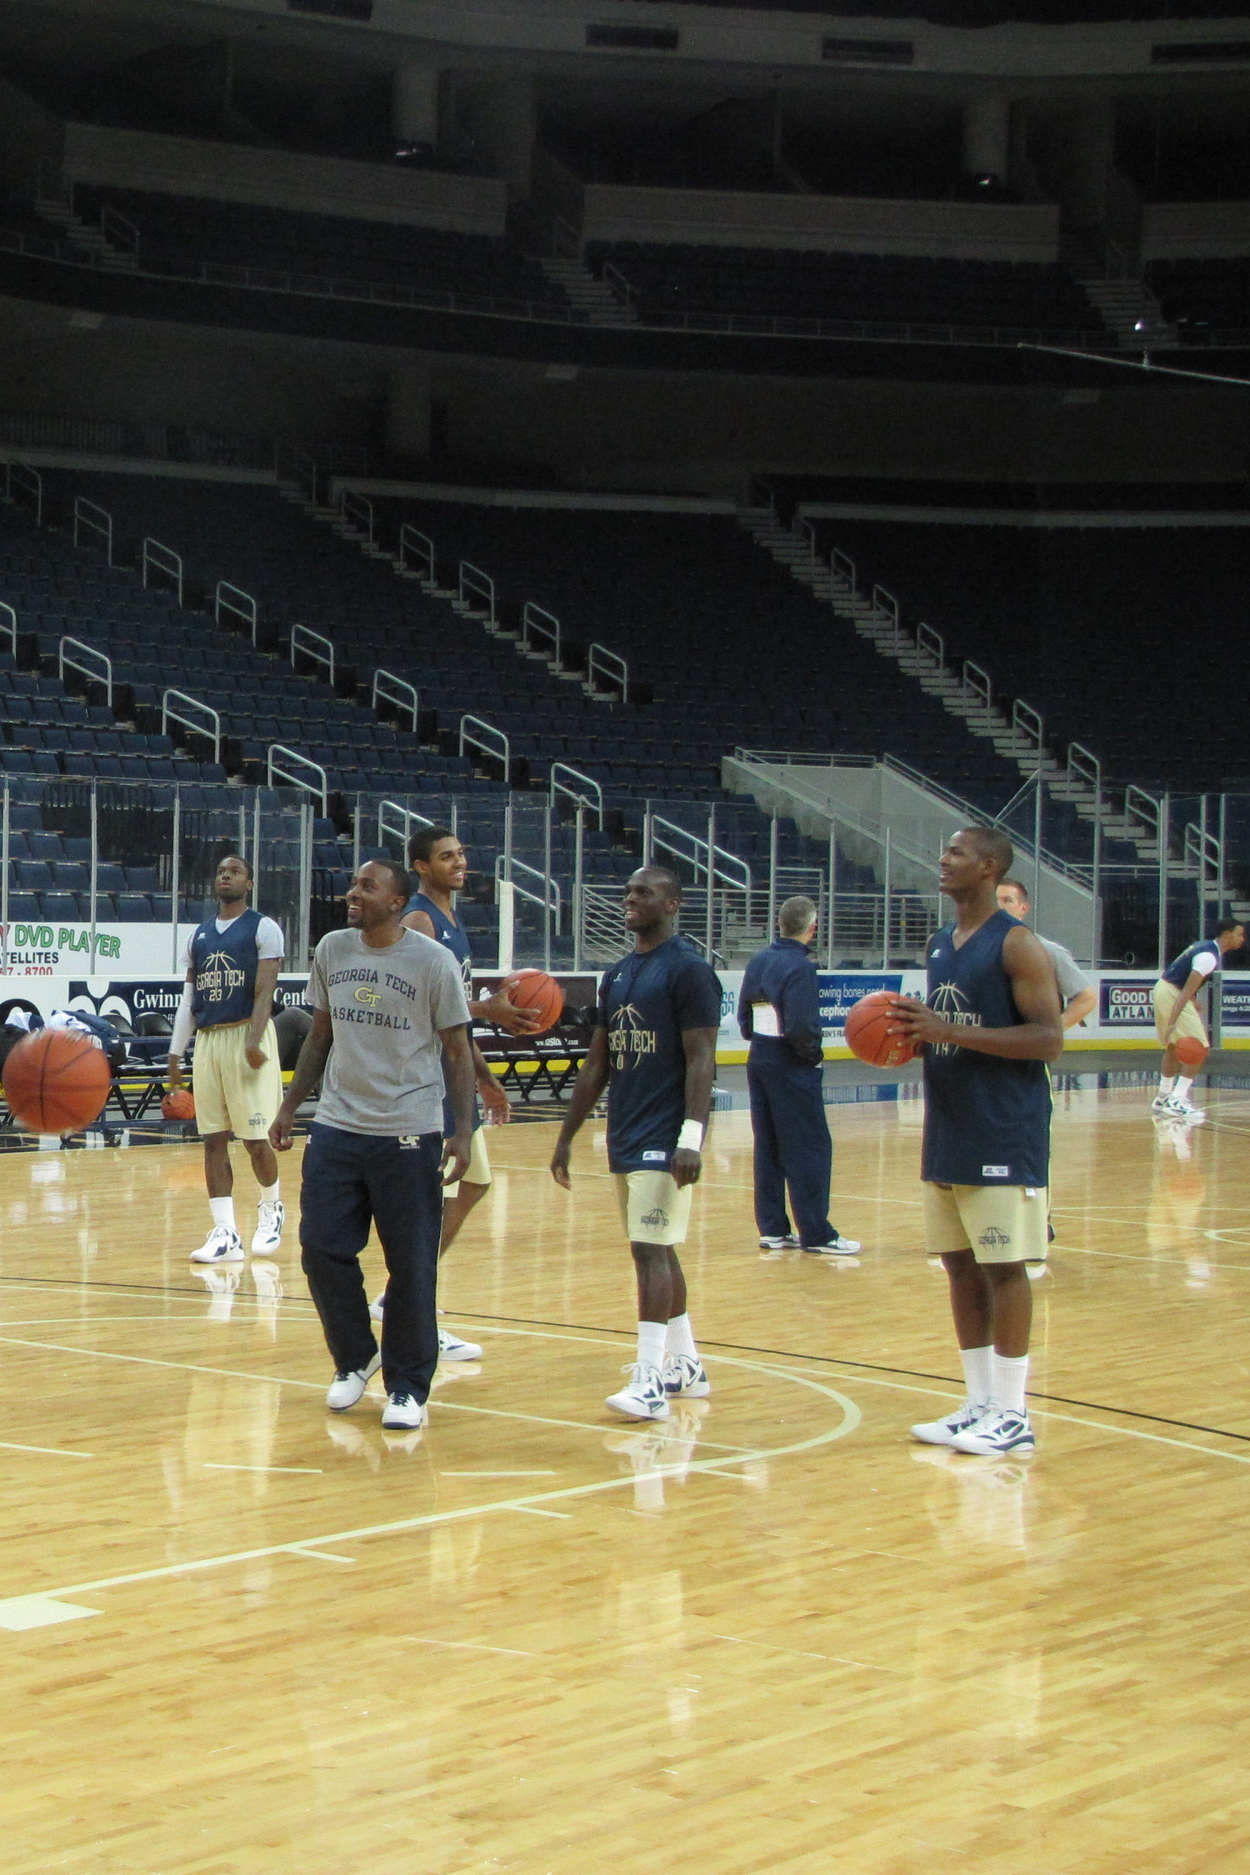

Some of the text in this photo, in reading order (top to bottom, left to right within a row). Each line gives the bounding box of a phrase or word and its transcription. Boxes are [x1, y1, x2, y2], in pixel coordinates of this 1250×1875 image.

[15, 924, 54, 947] DVD
[196, 970, 245, 991] GORGIA TECH
[328, 968, 417, 1001] GEORGIA TECH
[133, 987, 312, 1009] Gwinn Cent
[209, 989, 223, 1001] 23
[819, 984, 842, 1002] owing
[1111, 989, 1147, 1005] GOOD
[332, 1008, 411, 1031] ASKETBALL
[1112, 1006, 1154, 1018] ATLAN
[630, 1030, 656, 1053] TECH
